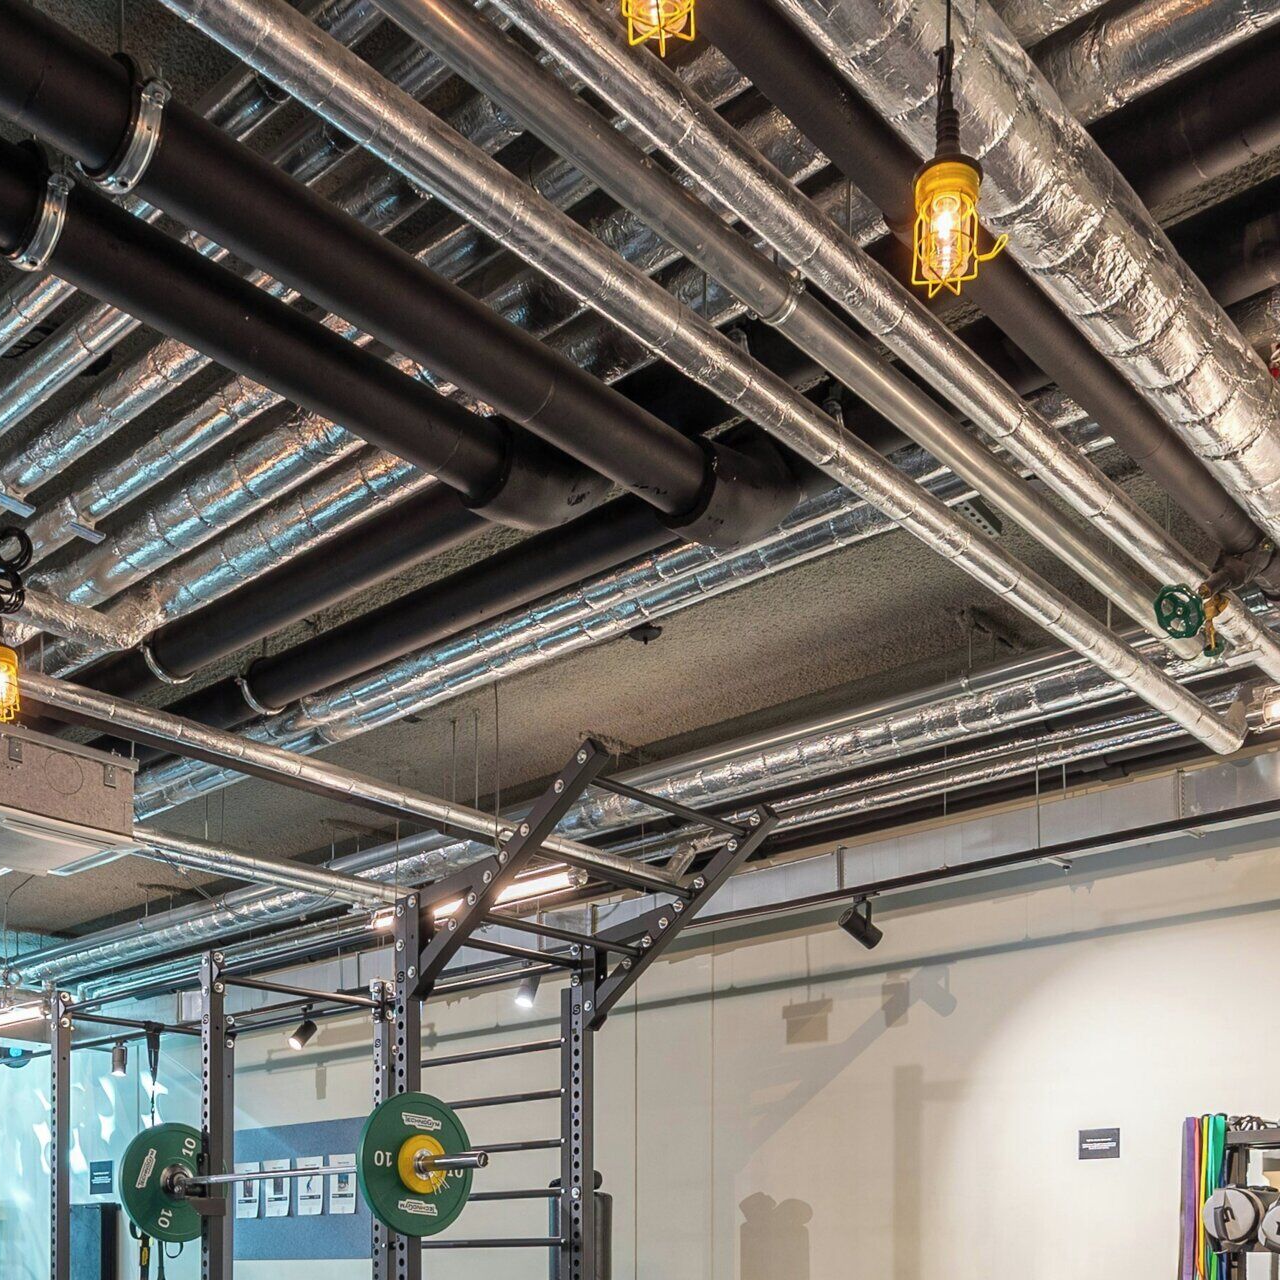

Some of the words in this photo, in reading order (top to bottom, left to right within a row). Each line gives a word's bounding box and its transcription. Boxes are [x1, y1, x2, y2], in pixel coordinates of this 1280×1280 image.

[182, 1137, 197, 1157] 10
[373, 1150, 393, 1167] 10
[158, 1208, 173, 1228] 10
